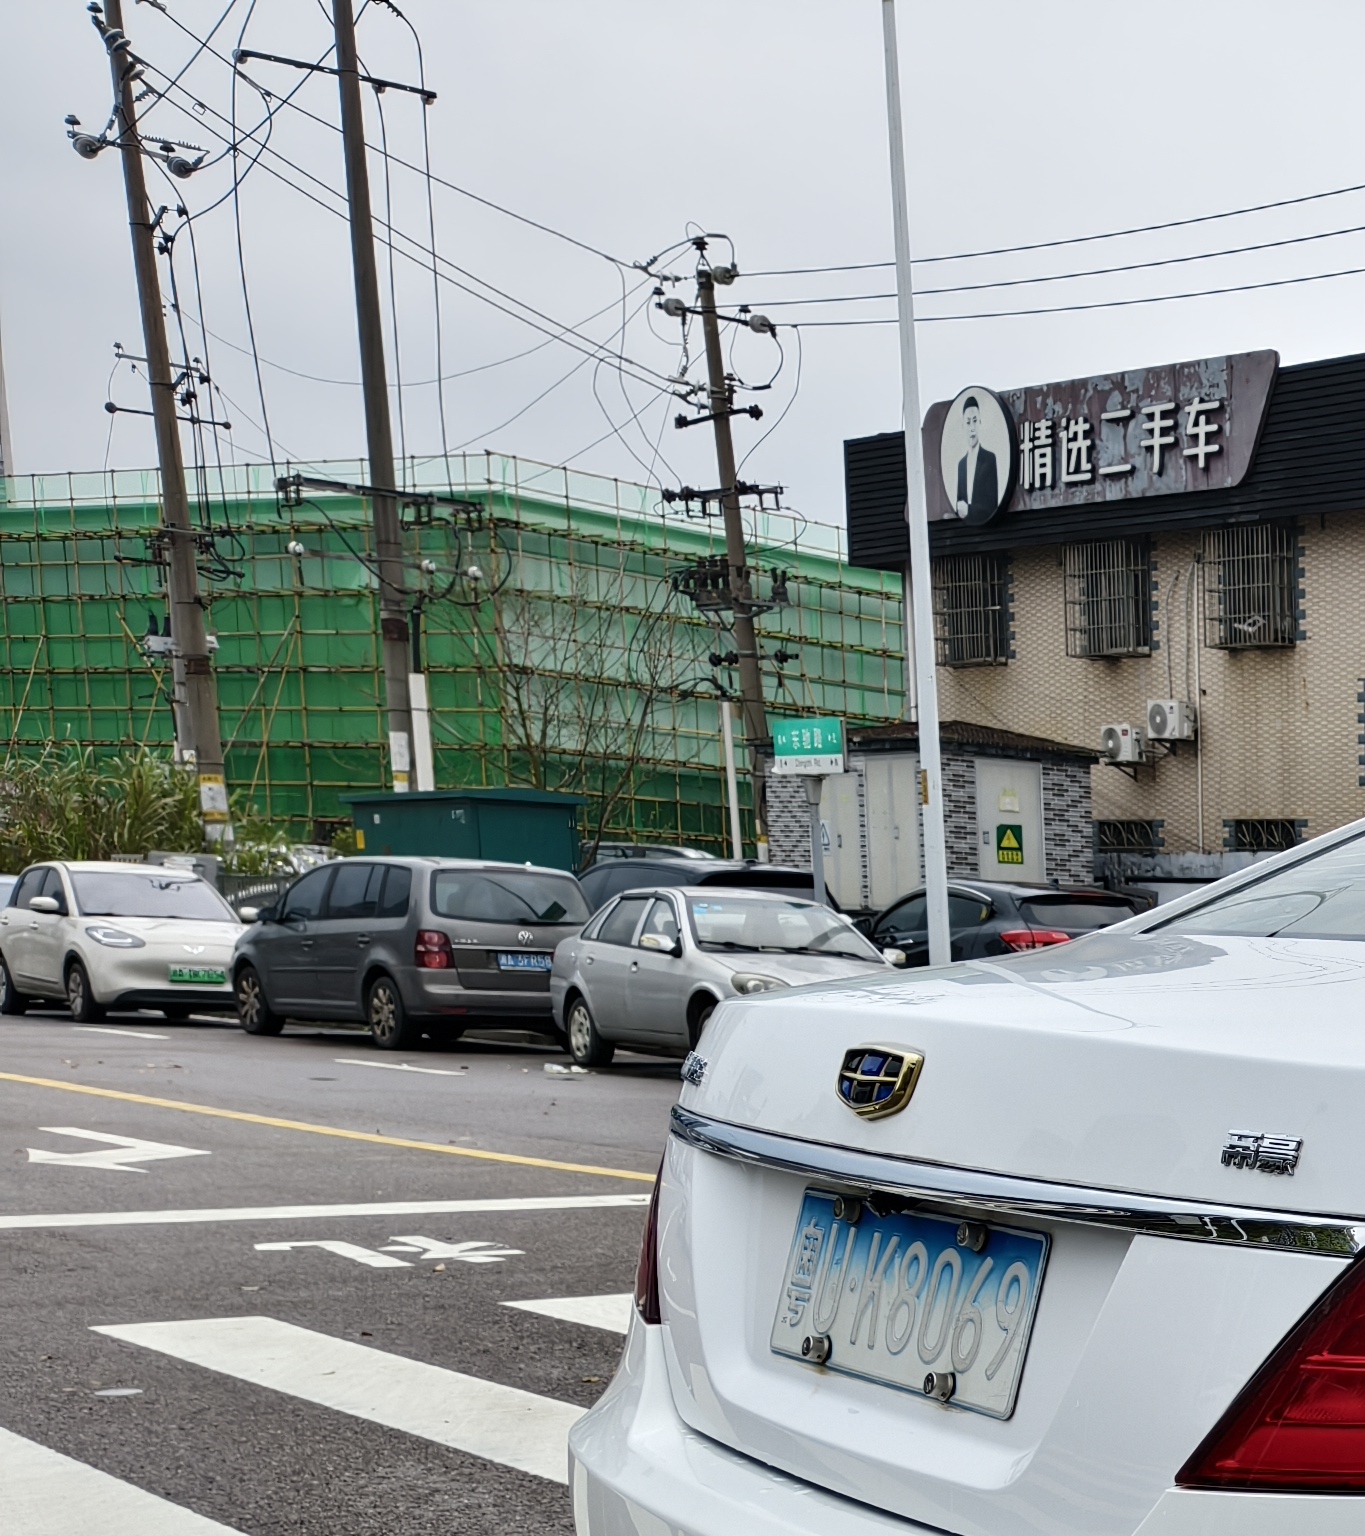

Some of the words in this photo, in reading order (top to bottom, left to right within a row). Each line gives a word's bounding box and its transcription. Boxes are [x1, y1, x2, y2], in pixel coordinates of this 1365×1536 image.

[1019, 397, 1220, 490] 精选二手车
